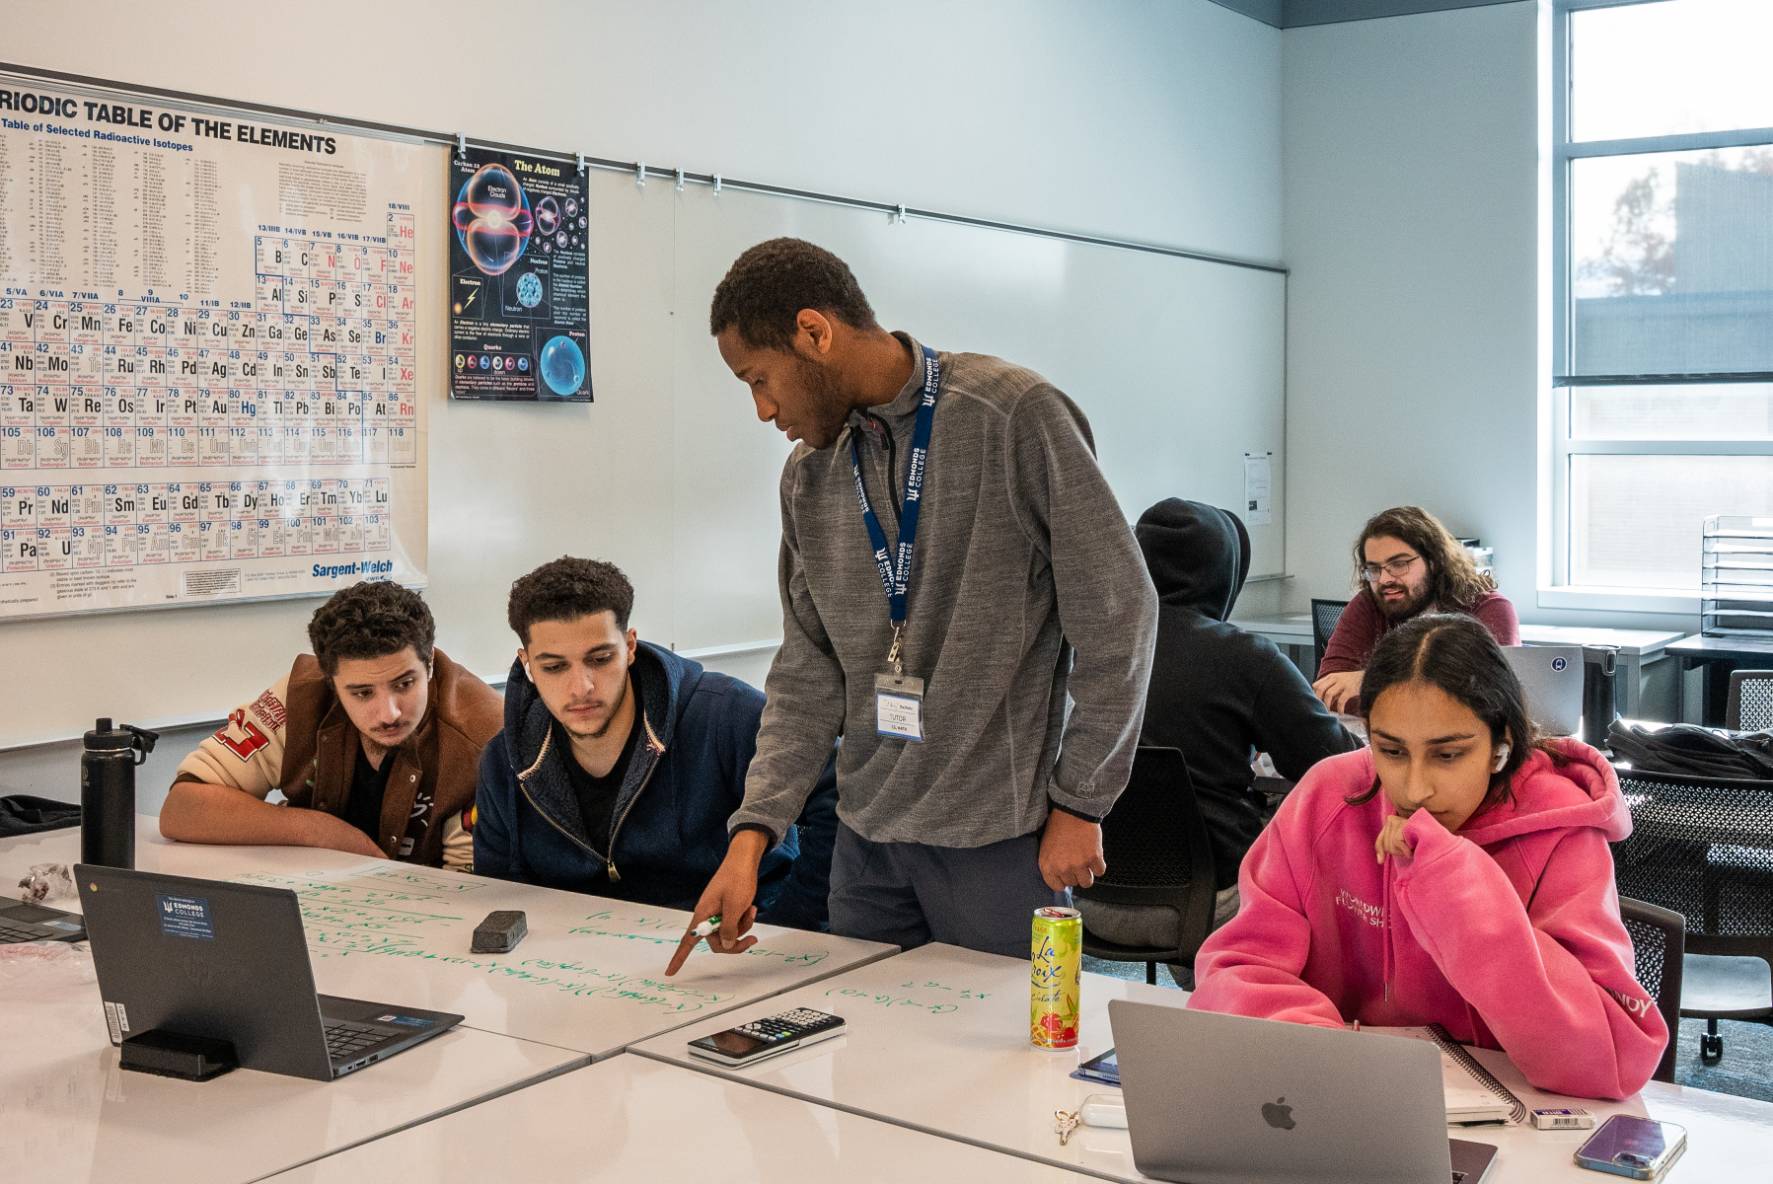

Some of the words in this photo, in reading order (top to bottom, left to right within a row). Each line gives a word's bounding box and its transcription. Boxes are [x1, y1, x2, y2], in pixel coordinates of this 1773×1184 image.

[0, 90, 77, 118] RIODIC
[84, 101, 153, 129] TABLE
[158, 112, 186, 133] OF
[191, 118, 232, 140] THE
[237, 124, 337, 155] ELEMENTS
[1, 118, 30, 131] Table
[33, 122, 43, 132] of
[46, 124, 91, 138] Selected
[93, 131, 151, 146] Radioactive
[153, 138, 193, 152] Isotopes
[514, 160, 533, 173] The
[534, 163, 560, 177] Atom
[400, 226, 414, 239] He
[275, 250, 282, 264] B
[301, 252, 308, 266] C
[328, 255, 335, 268] N
[380, 259, 387, 272] F
[400, 261, 414, 274] Ne
[6, 288, 27, 296] 5/VA
[39, 290, 64, 298] 6/VIA
[72, 292, 99, 300] 7/VIIA
[271, 288, 282, 302] Al
[298, 290, 308, 303] Si
[329, 292, 336, 305] P
[0, 300, 13, 309] 23
[36, 301, 48, 311] 24
[354, 294, 361, 307] S
[402, 297, 414, 309] Ar
[70, 303, 83, 313] 25
[104, 304, 116, 314] 26
[136, 307, 148, 316] 27
[167, 308, 179, 318] 28
[198, 310, 210, 319] 29
[24, 313, 33, 328] V
[53, 315, 68, 330] Cr
[229, 312, 240, 321] 30
[81, 316, 101, 331] Mn
[119, 318, 133, 333] Fe
[150, 319, 166, 334] Co
[184, 322, 196, 335] Ni
[212, 323, 227, 337] Cu
[242, 324, 255, 338] Zn
[268, 325, 282, 339] Ga
[294, 327, 308, 341] Ge
[323, 328, 336, 342] As
[348, 330, 361, 343] Se
[375, 331, 386, 344] Br
[402, 332, 414, 345] Kr
[0, 343, 12, 352] 41
[36, 344, 49, 353] 42
[71, 345, 83, 354] 43
[104, 345, 116, 354] 44
[136, 347, 148, 356] 45
[167, 348, 179, 357] 46
[198, 350, 210, 358] 47
[229, 350, 240, 359] 48
[15, 355, 33, 371] Nb
[48, 356, 68, 371] Mo
[118, 358, 134, 373] Ru
[150, 359, 165, 374] Rh
[182, 361, 197, 375] Pd
[242, 362, 257, 376] Cd
[212, 362, 227, 378] Ag
[273, 363, 283, 377] In
[295, 364, 309, 378] Sn
[322, 365, 336, 379] Sb
[350, 366, 361, 379] Te
[400, 367, 414, 380] Xe
[931, 359, 939, 394] COLLEGE
[18, 397, 34, 412] Ta
[54, 398, 68, 412] W
[84, 398, 102, 413] Re
[118, 398, 134, 413] Os
[156, 399, 165, 413] Ir
[184, 400, 197, 413] Pt
[212, 400, 227, 414] Au
[241, 400, 256, 417] Hg
[296, 401, 309, 415] Pb
[325, 402, 335, 415] Bi
[348, 402, 361, 415] Po
[375, 403, 386, 416] At
[400, 403, 414, 416] Rn
[2, 427, 21, 437] 105
[37, 428, 56, 437] 106
[71, 428, 90, 437] 107
[105, 428, 122, 437] 108
[137, 428, 154, 437] 109
[168, 428, 185, 437] 110
[199, 428, 216, 437] 111
[230, 428, 246, 437] 112
[285, 428, 300, 437] 114
[312, 428, 326, 437] 115
[389, 428, 404, 437] 118
[909, 447, 920, 488] EDMONDS
[915, 448, 926, 488] COLLEGE
[215, 495, 229, 509] Tb
[244, 494, 258, 510] Dy
[270, 493, 285, 507] Ho
[300, 493, 310, 506] Er
[321, 492, 337, 505] Tm
[349, 491, 363, 504] Yb
[376, 490, 388, 502] Lu
[18, 500, 33, 515] Pr
[52, 500, 69, 514] Nd
[115, 498, 135, 512] Sm
[152, 497, 167, 511] Eu
[182, 496, 198, 510] Gd
[72, 528, 85, 537] 93
[105, 526, 118, 536] 94
[137, 525, 150, 534] 95
[169, 523, 182, 533] 96
[20, 543, 37, 558] Pa
[62, 541, 71, 555] U
[896, 542, 906, 581] EDMONDS
[903, 543, 913, 582] COLLEGE
[312, 559, 393, 579] Sargent-Welch
[173, 902, 204, 912] EDMONDS
[175, 908, 204, 918] COLLEGE
